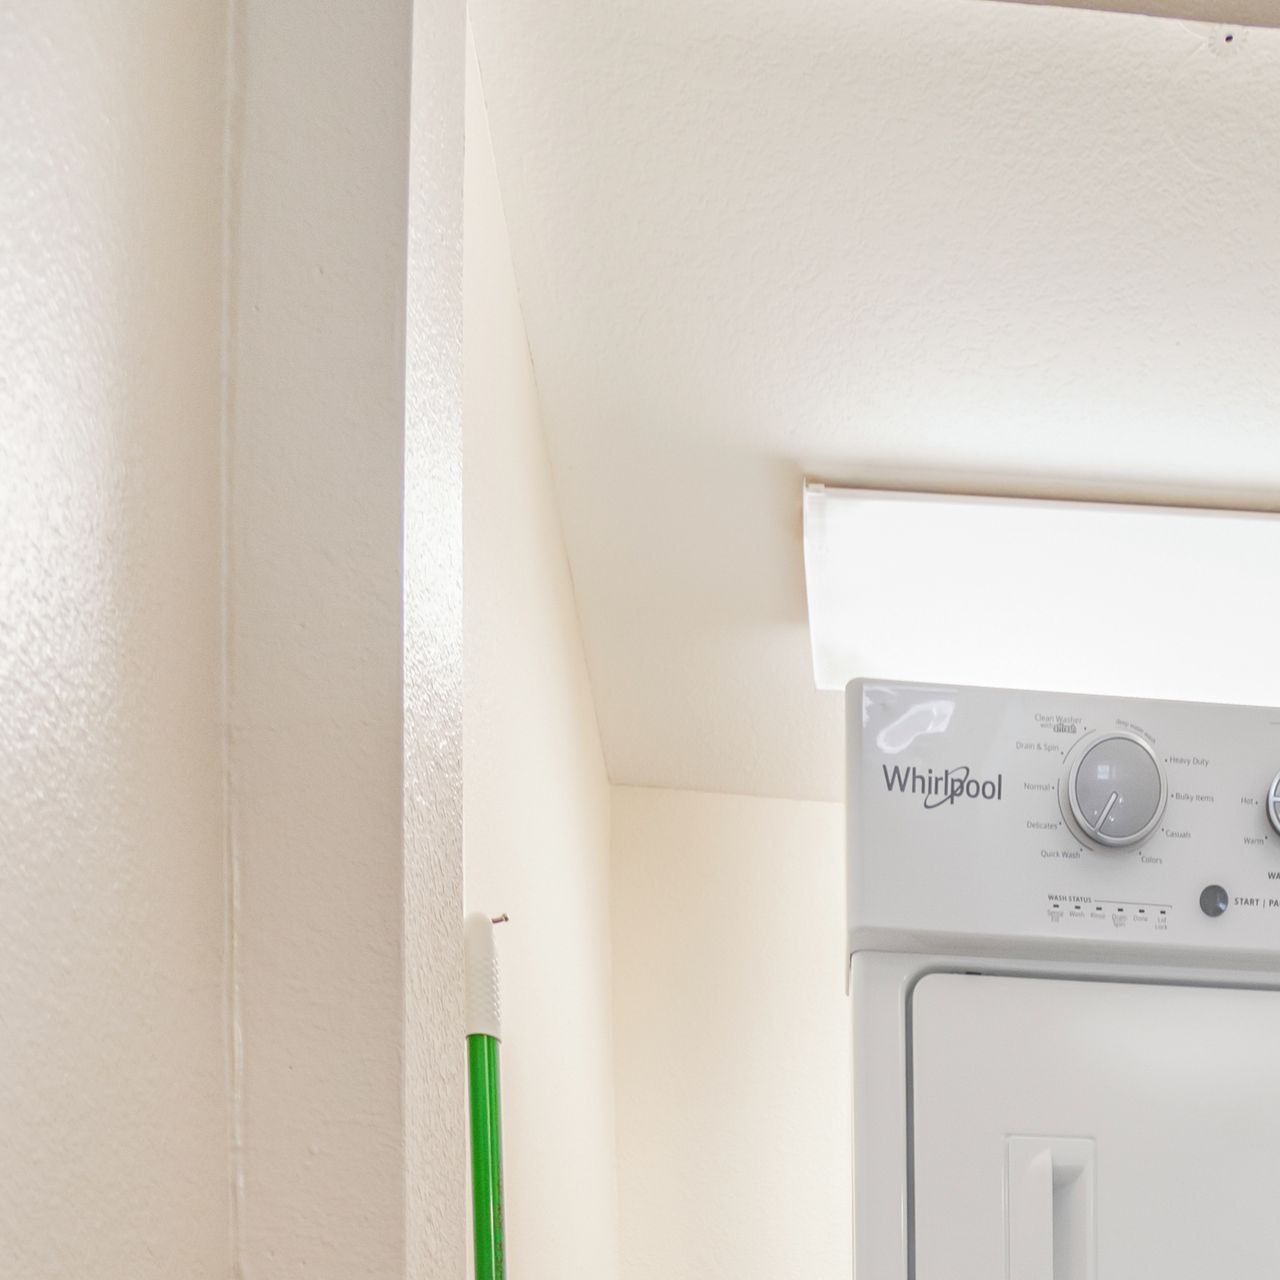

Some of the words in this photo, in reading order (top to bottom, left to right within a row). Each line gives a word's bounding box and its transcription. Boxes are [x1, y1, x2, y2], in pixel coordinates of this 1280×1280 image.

[1016, 741, 1035, 750] Drain
[1036, 743, 1042, 751] &
[1169, 756, 1191, 766] Heavy
[1192, 757, 1209, 767] Duty
[882, 764, 1002, 809] Whirlpool
[1024, 782, 1051, 791] Normal
[1175, 792, 1194, 802] Bulky
[1241, 797, 1254, 806] Hot
[1027, 821, 1057, 830] Delicates
[1243, 837, 1265, 846] Warm
[1040, 849, 1060, 859] Quick
[1061, 850, 1081, 859] Wash
[1141, 855, 1162, 864] Colors
[1047, 894, 1067, 902] WASH
[1068, 895, 1092, 904] STATUS
[1234, 897, 1260, 907] START
